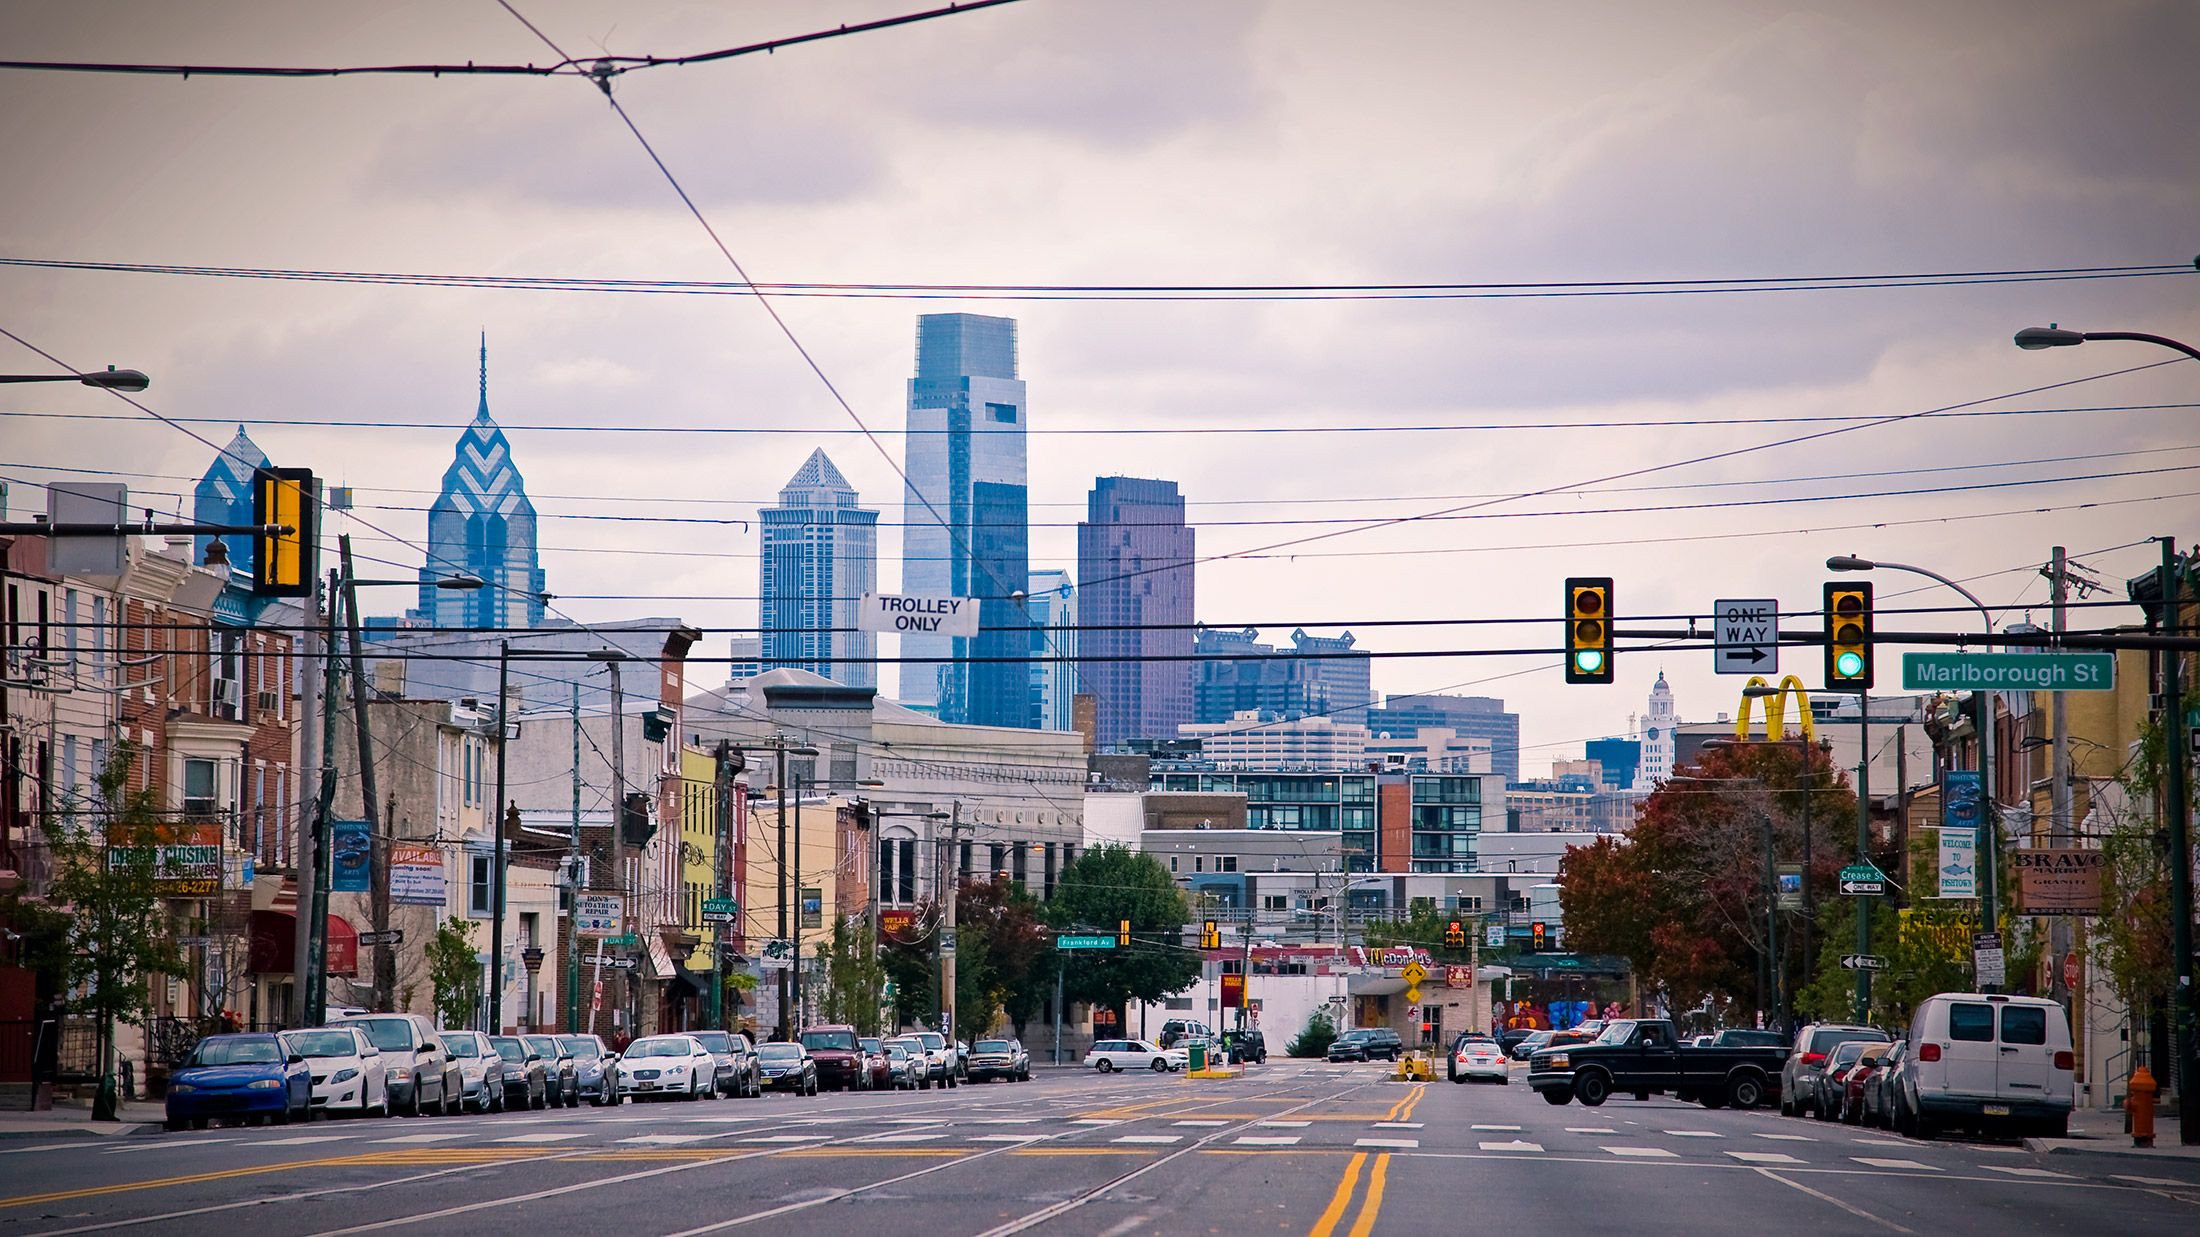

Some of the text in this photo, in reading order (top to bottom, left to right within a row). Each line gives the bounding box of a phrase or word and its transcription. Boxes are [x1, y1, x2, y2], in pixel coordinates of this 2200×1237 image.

[879, 597, 961, 615] TROLLEY
[895, 615, 942, 632] ONLY
[1727, 608, 1768, 624] ONE
[1726, 627, 1769, 643] WAY
[1916, 663, 2099, 687] Marlborough St
[1942, 839, 1972, 849] WELCOME
[163, 846, 218, 863] CUISINE
[391, 850, 441, 864] AVAILABLE
[1952, 852, 1962, 862] TO
[2015, 853, 2106, 868] BRAVO
[1841, 871, 1872, 880] Crease
[1941, 879, 1972, 888] FISHTOWN
[1371, 948, 1432, 966] McDonald's
[2066, 964, 2079, 978] STOP
